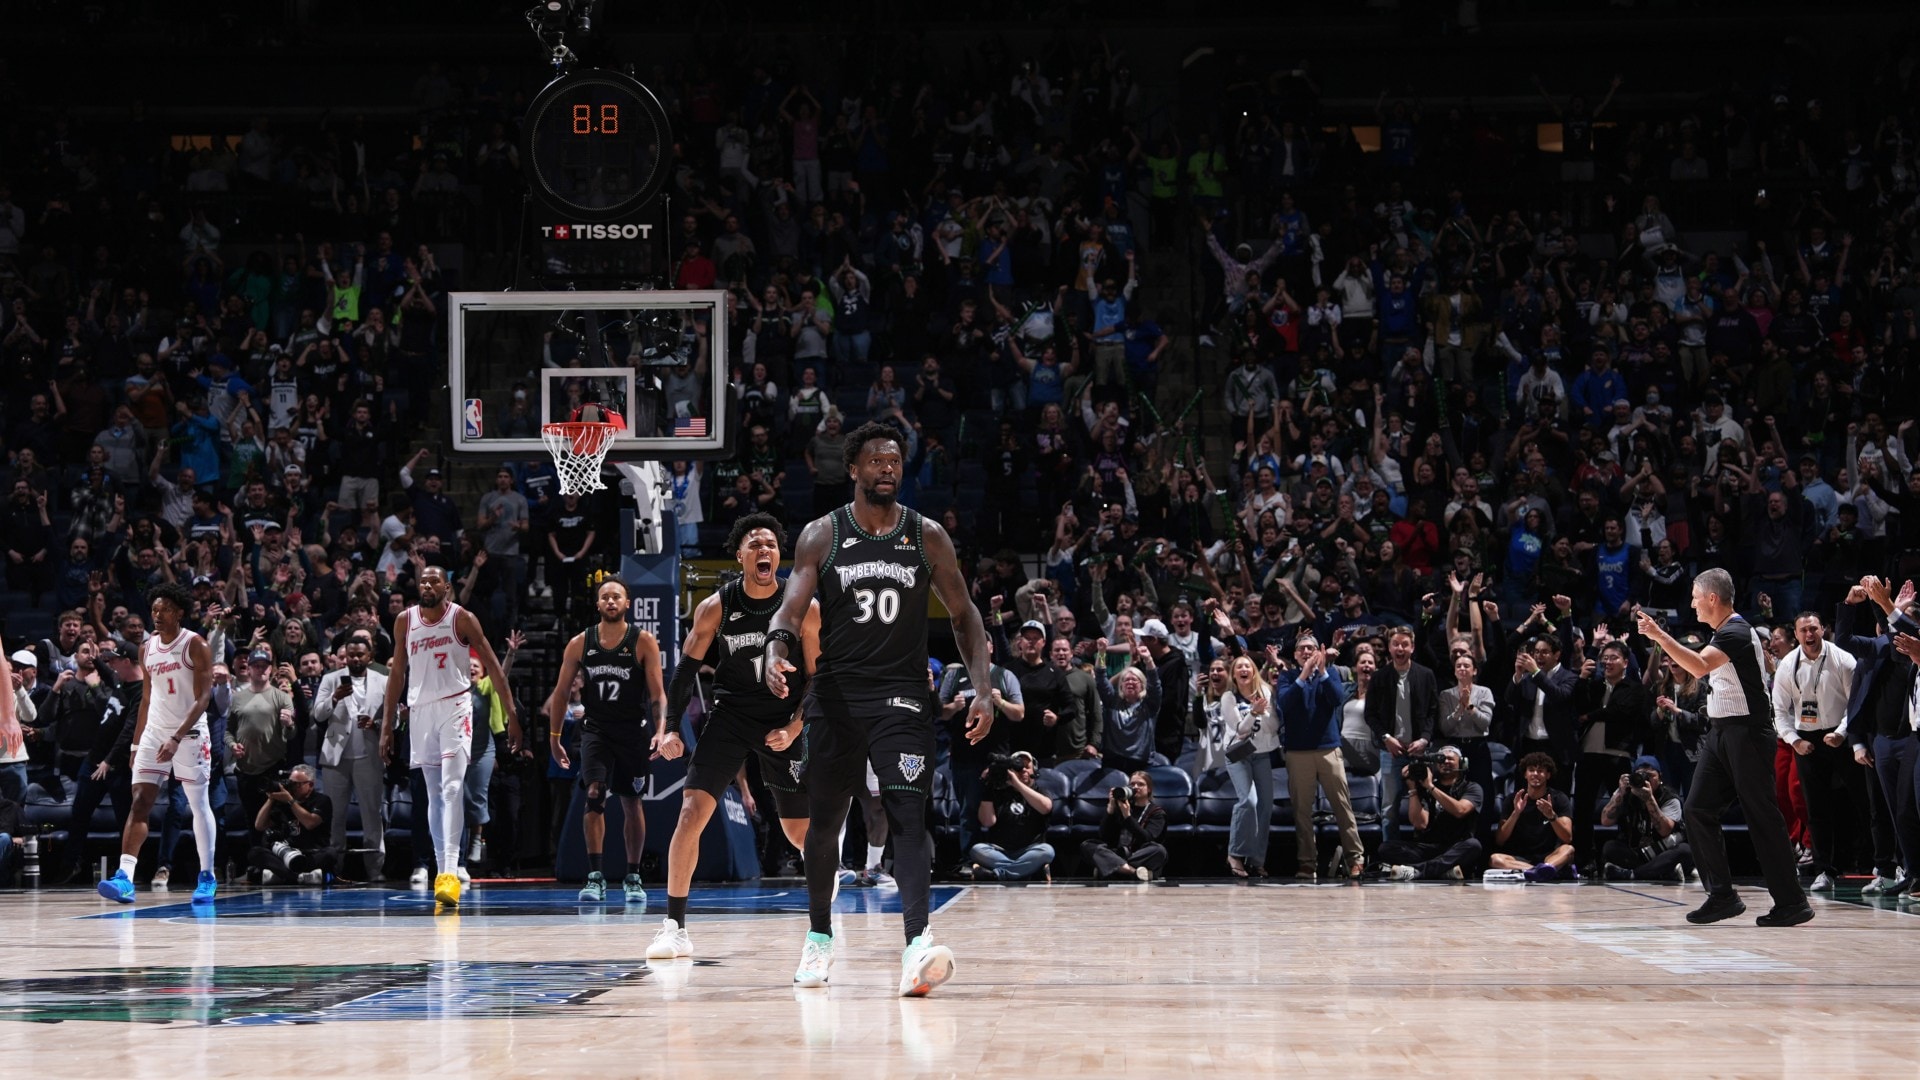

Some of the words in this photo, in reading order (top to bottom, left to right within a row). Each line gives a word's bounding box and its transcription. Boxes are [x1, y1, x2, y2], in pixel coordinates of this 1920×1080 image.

[573, 104, 619, 134] 8.8
[572, 225, 653, 239] TISSOT
[1003, 462, 1012, 476] 5
[834, 560, 920, 593] TIMBERWOLVES
[1605, 575, 1614, 588] 3
[634, 598, 660, 620] GET
[853, 588, 901, 625] 30
[1324, 612, 1332, 624] 5
[411, 636, 453, 656] H-Town
[434, 653, 447, 669] 7
[168, 678, 176, 694] 1
[596, 680, 620, 701] 12
[1212, 723, 1221, 743] 2
[1253, 719, 1261, 733] 5
